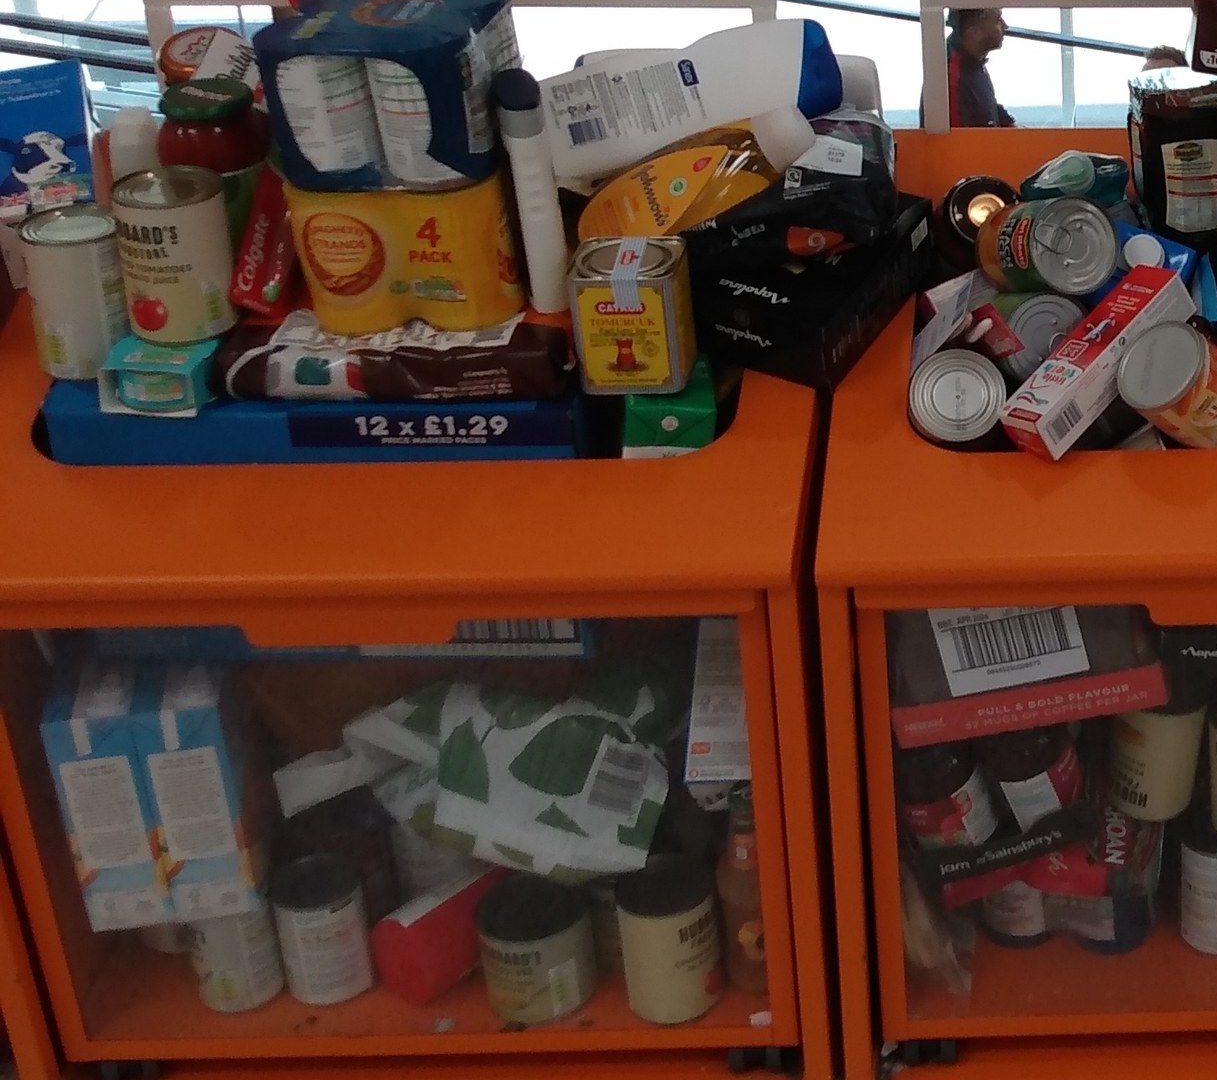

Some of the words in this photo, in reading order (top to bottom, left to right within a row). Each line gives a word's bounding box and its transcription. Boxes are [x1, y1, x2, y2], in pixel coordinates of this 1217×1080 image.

[629, 165, 669, 227] Johnson's
[416, 216, 441, 248] 4
[237, 213, 271, 292] Colgate
[409, 250, 452, 264] PACK
[719, 277, 791, 305] Napolina
[715, 323, 773, 349] Napolina
[354, 415, 389, 436] 12
[398, 420, 416, 436] x
[423, 415, 509, 436] £1.29
[381, 437, 410, 445] PRICE
[412, 437, 453, 445] MARKED
[455, 436, 487, 445] PACKS
[977, 706, 1001, 716] FULL
[1015, 703, 1024, 712] &
[1027, 695, 1064, 708] BOLD
[1067, 683, 1131, 703] FLAVOUR
[983, 716, 1014, 729] MUGS
[1016, 713, 1030, 723] OF
[1033, 704, 1095, 721] COFFEE
[1096, 698, 1121, 709] PER
[1125, 691, 1149, 703] JAR
[984, 830, 1062, 861] Sainsbury's
[940, 859, 971, 877] jam
